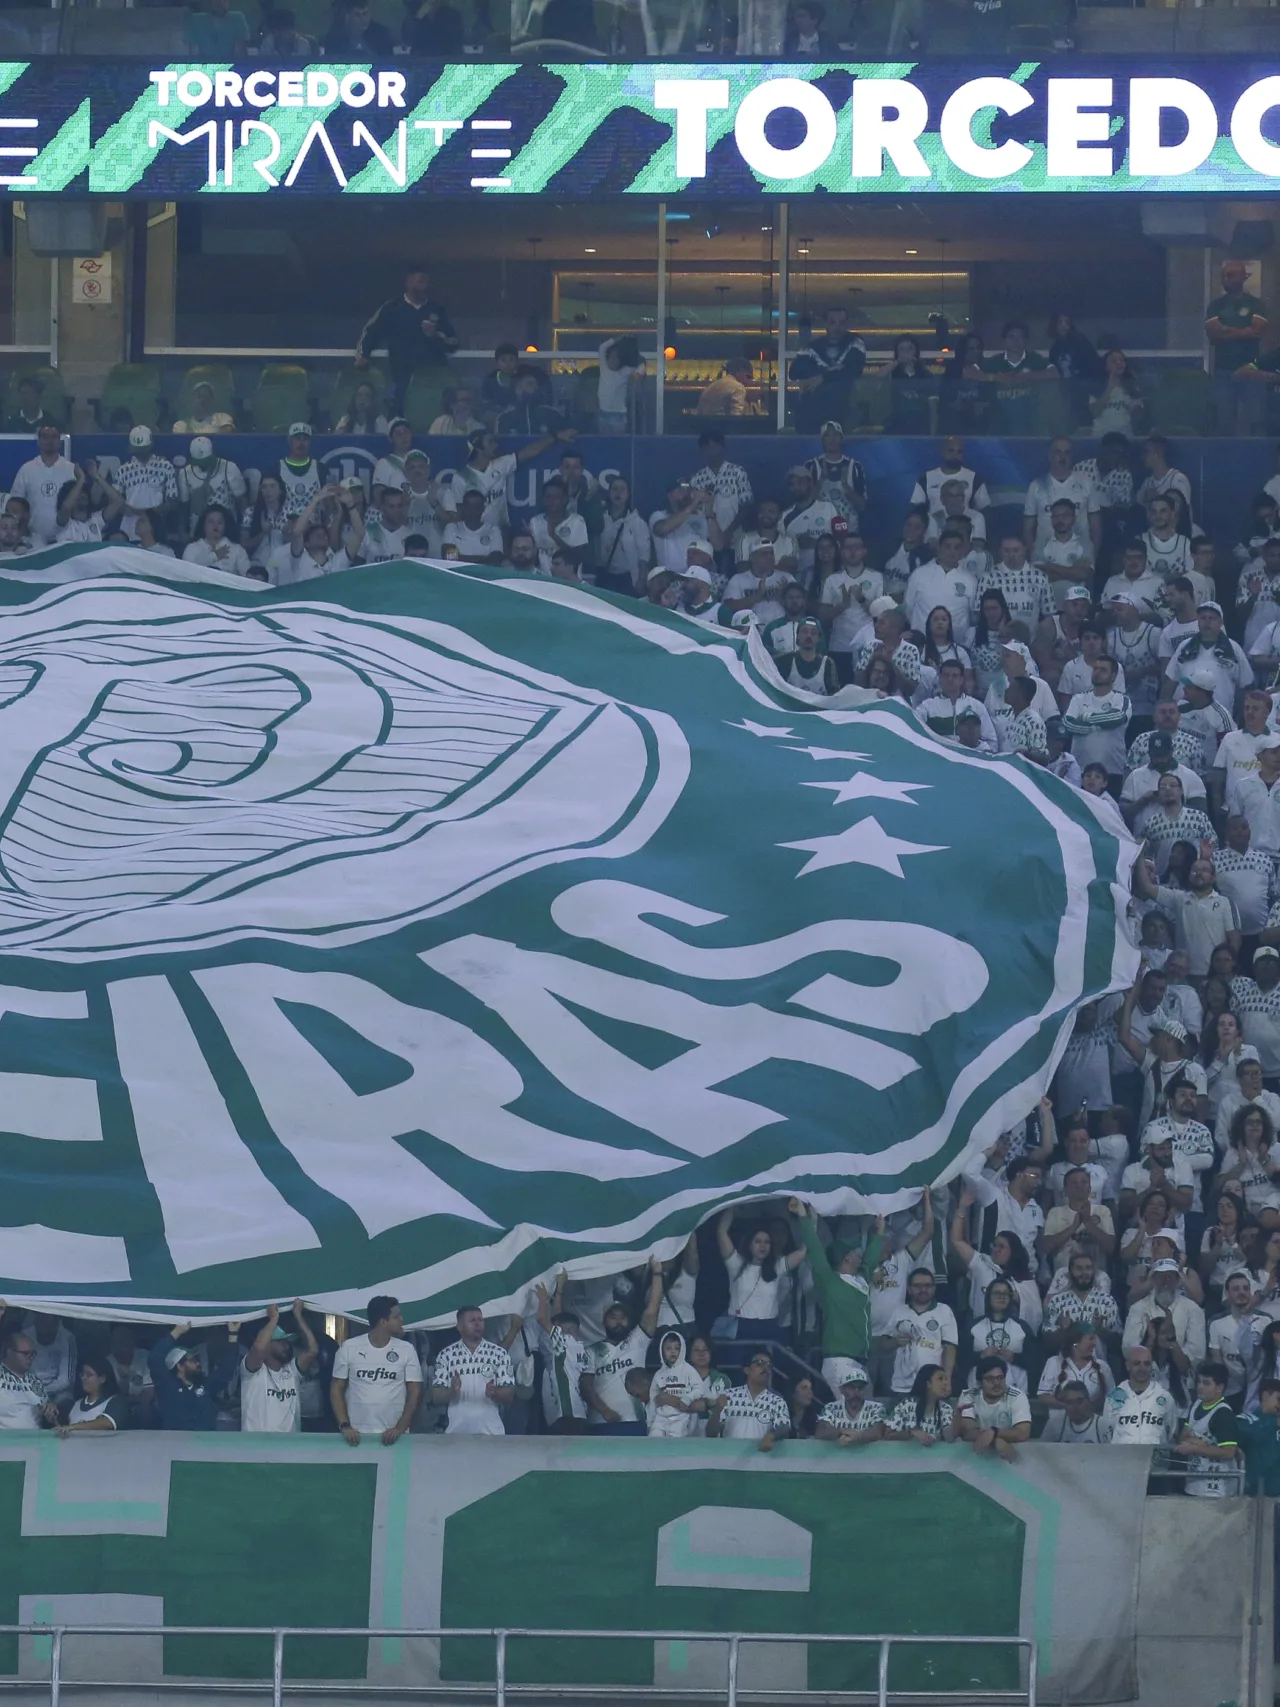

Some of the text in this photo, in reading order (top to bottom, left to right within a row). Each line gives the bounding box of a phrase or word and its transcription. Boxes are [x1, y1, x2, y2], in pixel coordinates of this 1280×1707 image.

[149, 69, 407, 108] TORCEDOR
[148, 118, 512, 187] MIRANTE
[356, 1367, 397, 1382] crefisa
[596, 1356, 634, 1376] crefisa
[267, 1387, 297, 1402] crefisa
[1118, 1411, 1164, 1428] crefisa
